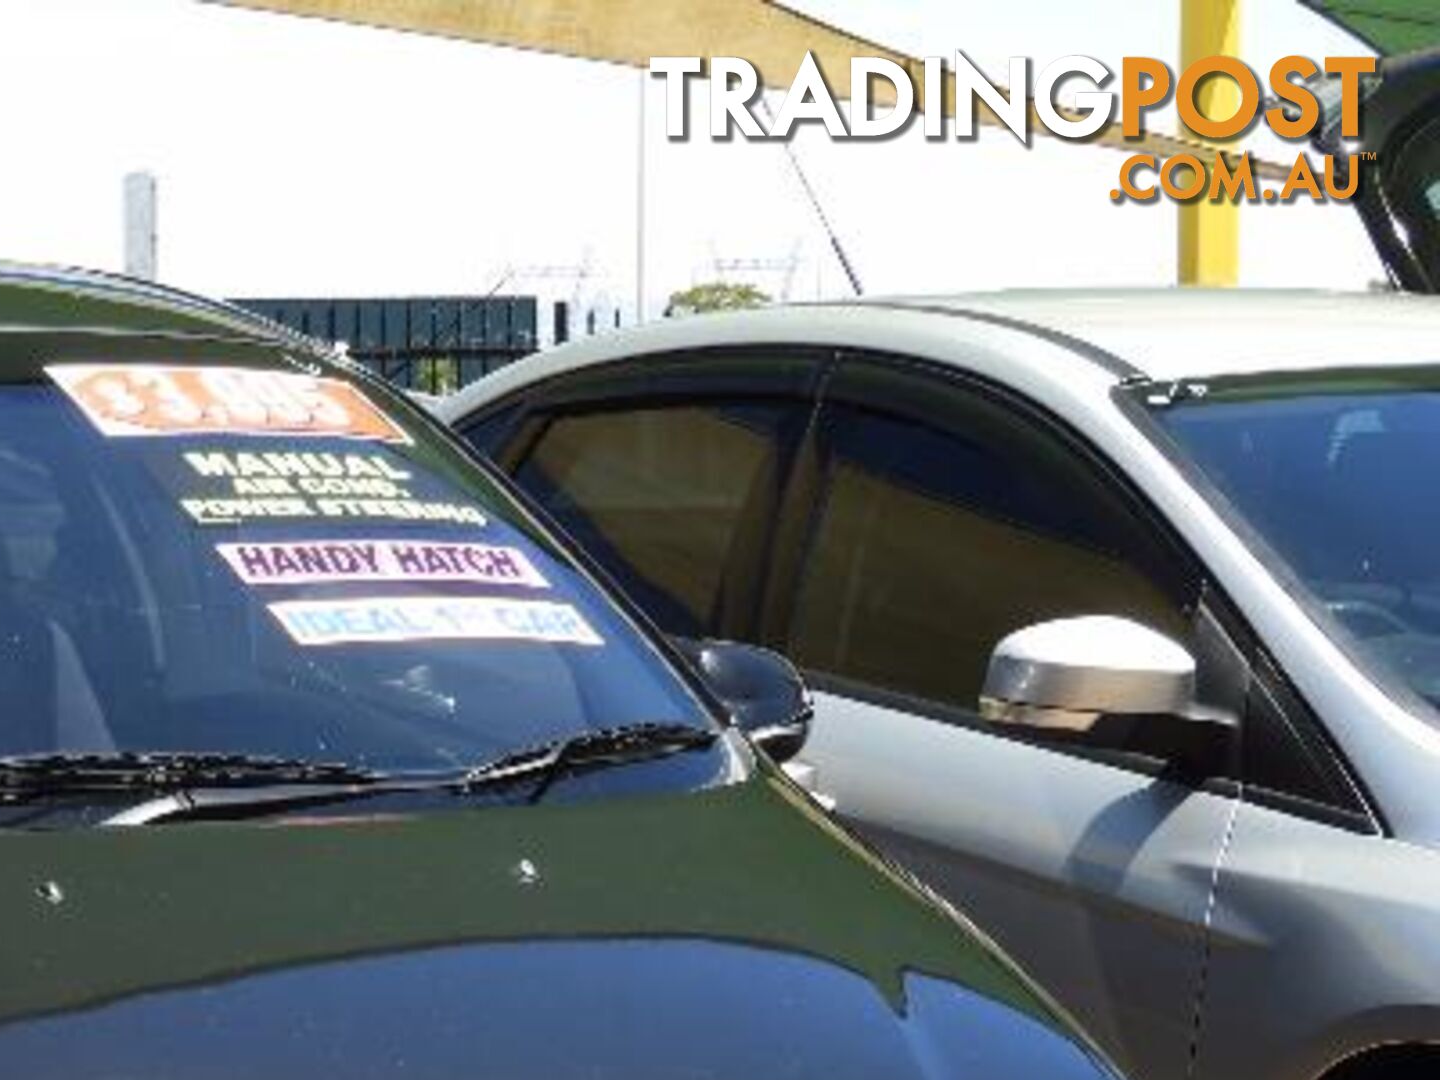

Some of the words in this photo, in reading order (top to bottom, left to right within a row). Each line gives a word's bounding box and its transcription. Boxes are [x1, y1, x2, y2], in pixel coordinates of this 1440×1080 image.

[183, 452, 411, 479] MANUAL
[237, 546, 378, 576] HANDY
[392, 546, 521, 577] HATCH
[288, 605, 434, 637] IDEAL
